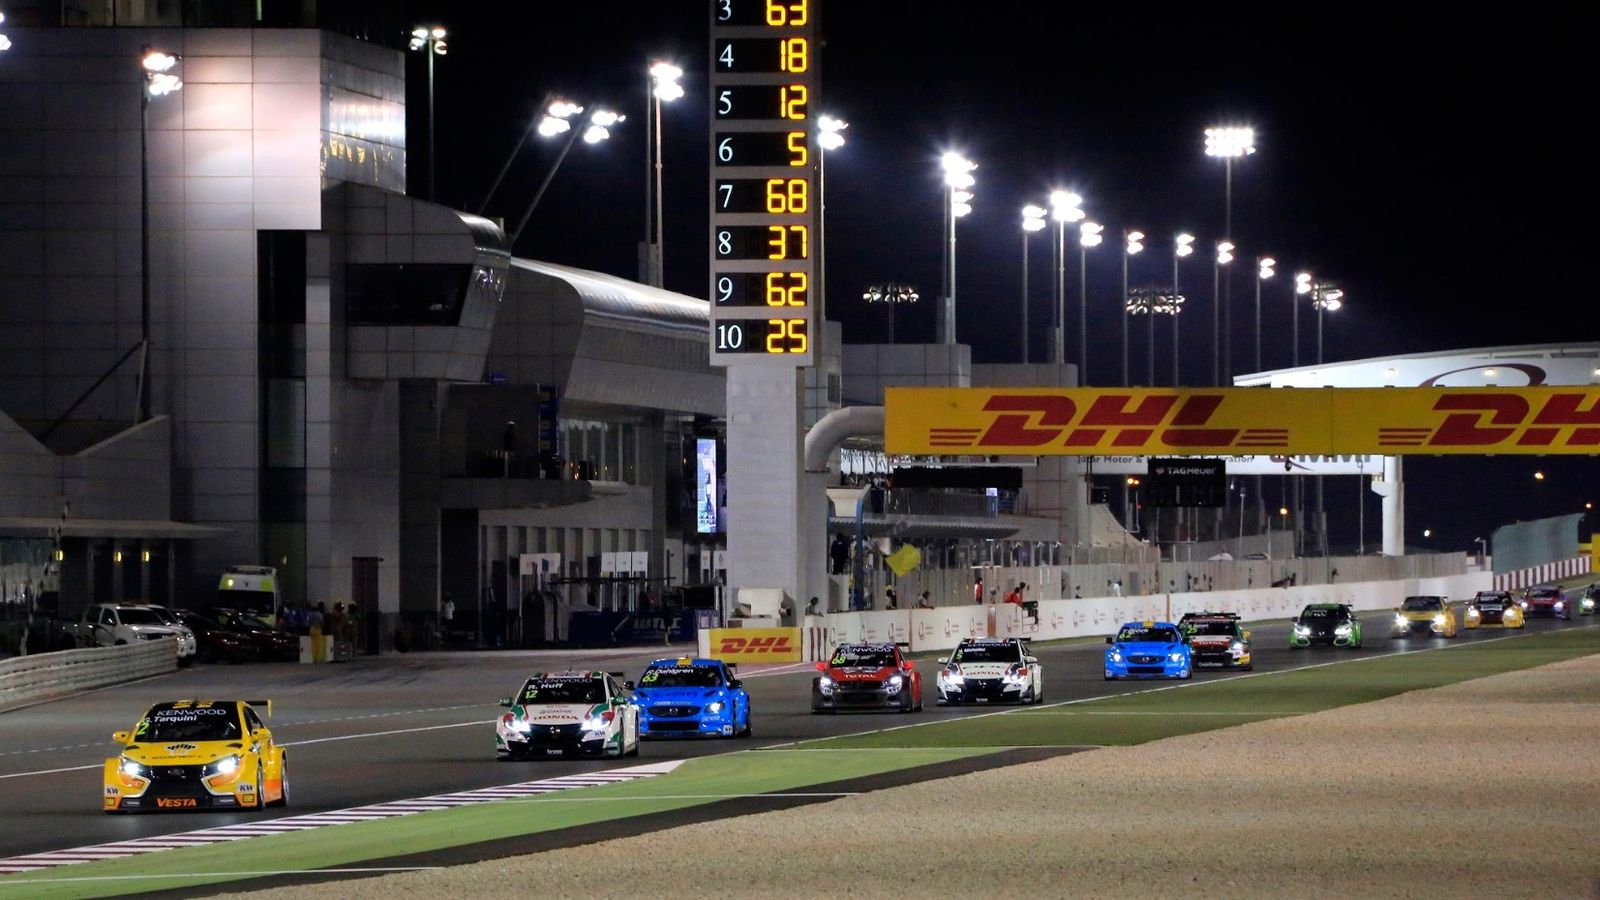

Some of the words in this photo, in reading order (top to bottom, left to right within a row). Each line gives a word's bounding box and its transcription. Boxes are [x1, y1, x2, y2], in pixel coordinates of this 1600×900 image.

[719, 0, 731, 20] 3
[767, 0, 807, 25] 63
[719, 44, 734, 68] 4
[781, 38, 807, 73] 18
[719, 91, 732, 115] 5
[781, 85, 807, 119] 12
[719, 137, 733, 162] 6
[788, 132, 807, 166] 5
[719, 184, 733, 208] 7
[767, 179, 807, 213] 68
[719, 231, 731, 255] 8
[768, 226, 807, 260] 37
[718, 277, 733, 302] 9
[767, 272, 807, 307] 62
[718, 325, 742, 349] 10
[767, 319, 807, 353] 25
[977, 395, 1225, 446] DHL
[719, 637, 792, 654] DHL
[832, 655, 848, 665] 68
[541, 682, 564, 690] Huff
[642, 672, 659, 683] 63
[525, 690, 539, 699] 12
[154, 714, 198, 723] Tarquini
[156, 708, 227, 716] KENWOOD
[239, 784, 254, 792] KW
[156, 798, 197, 808] VESTA
